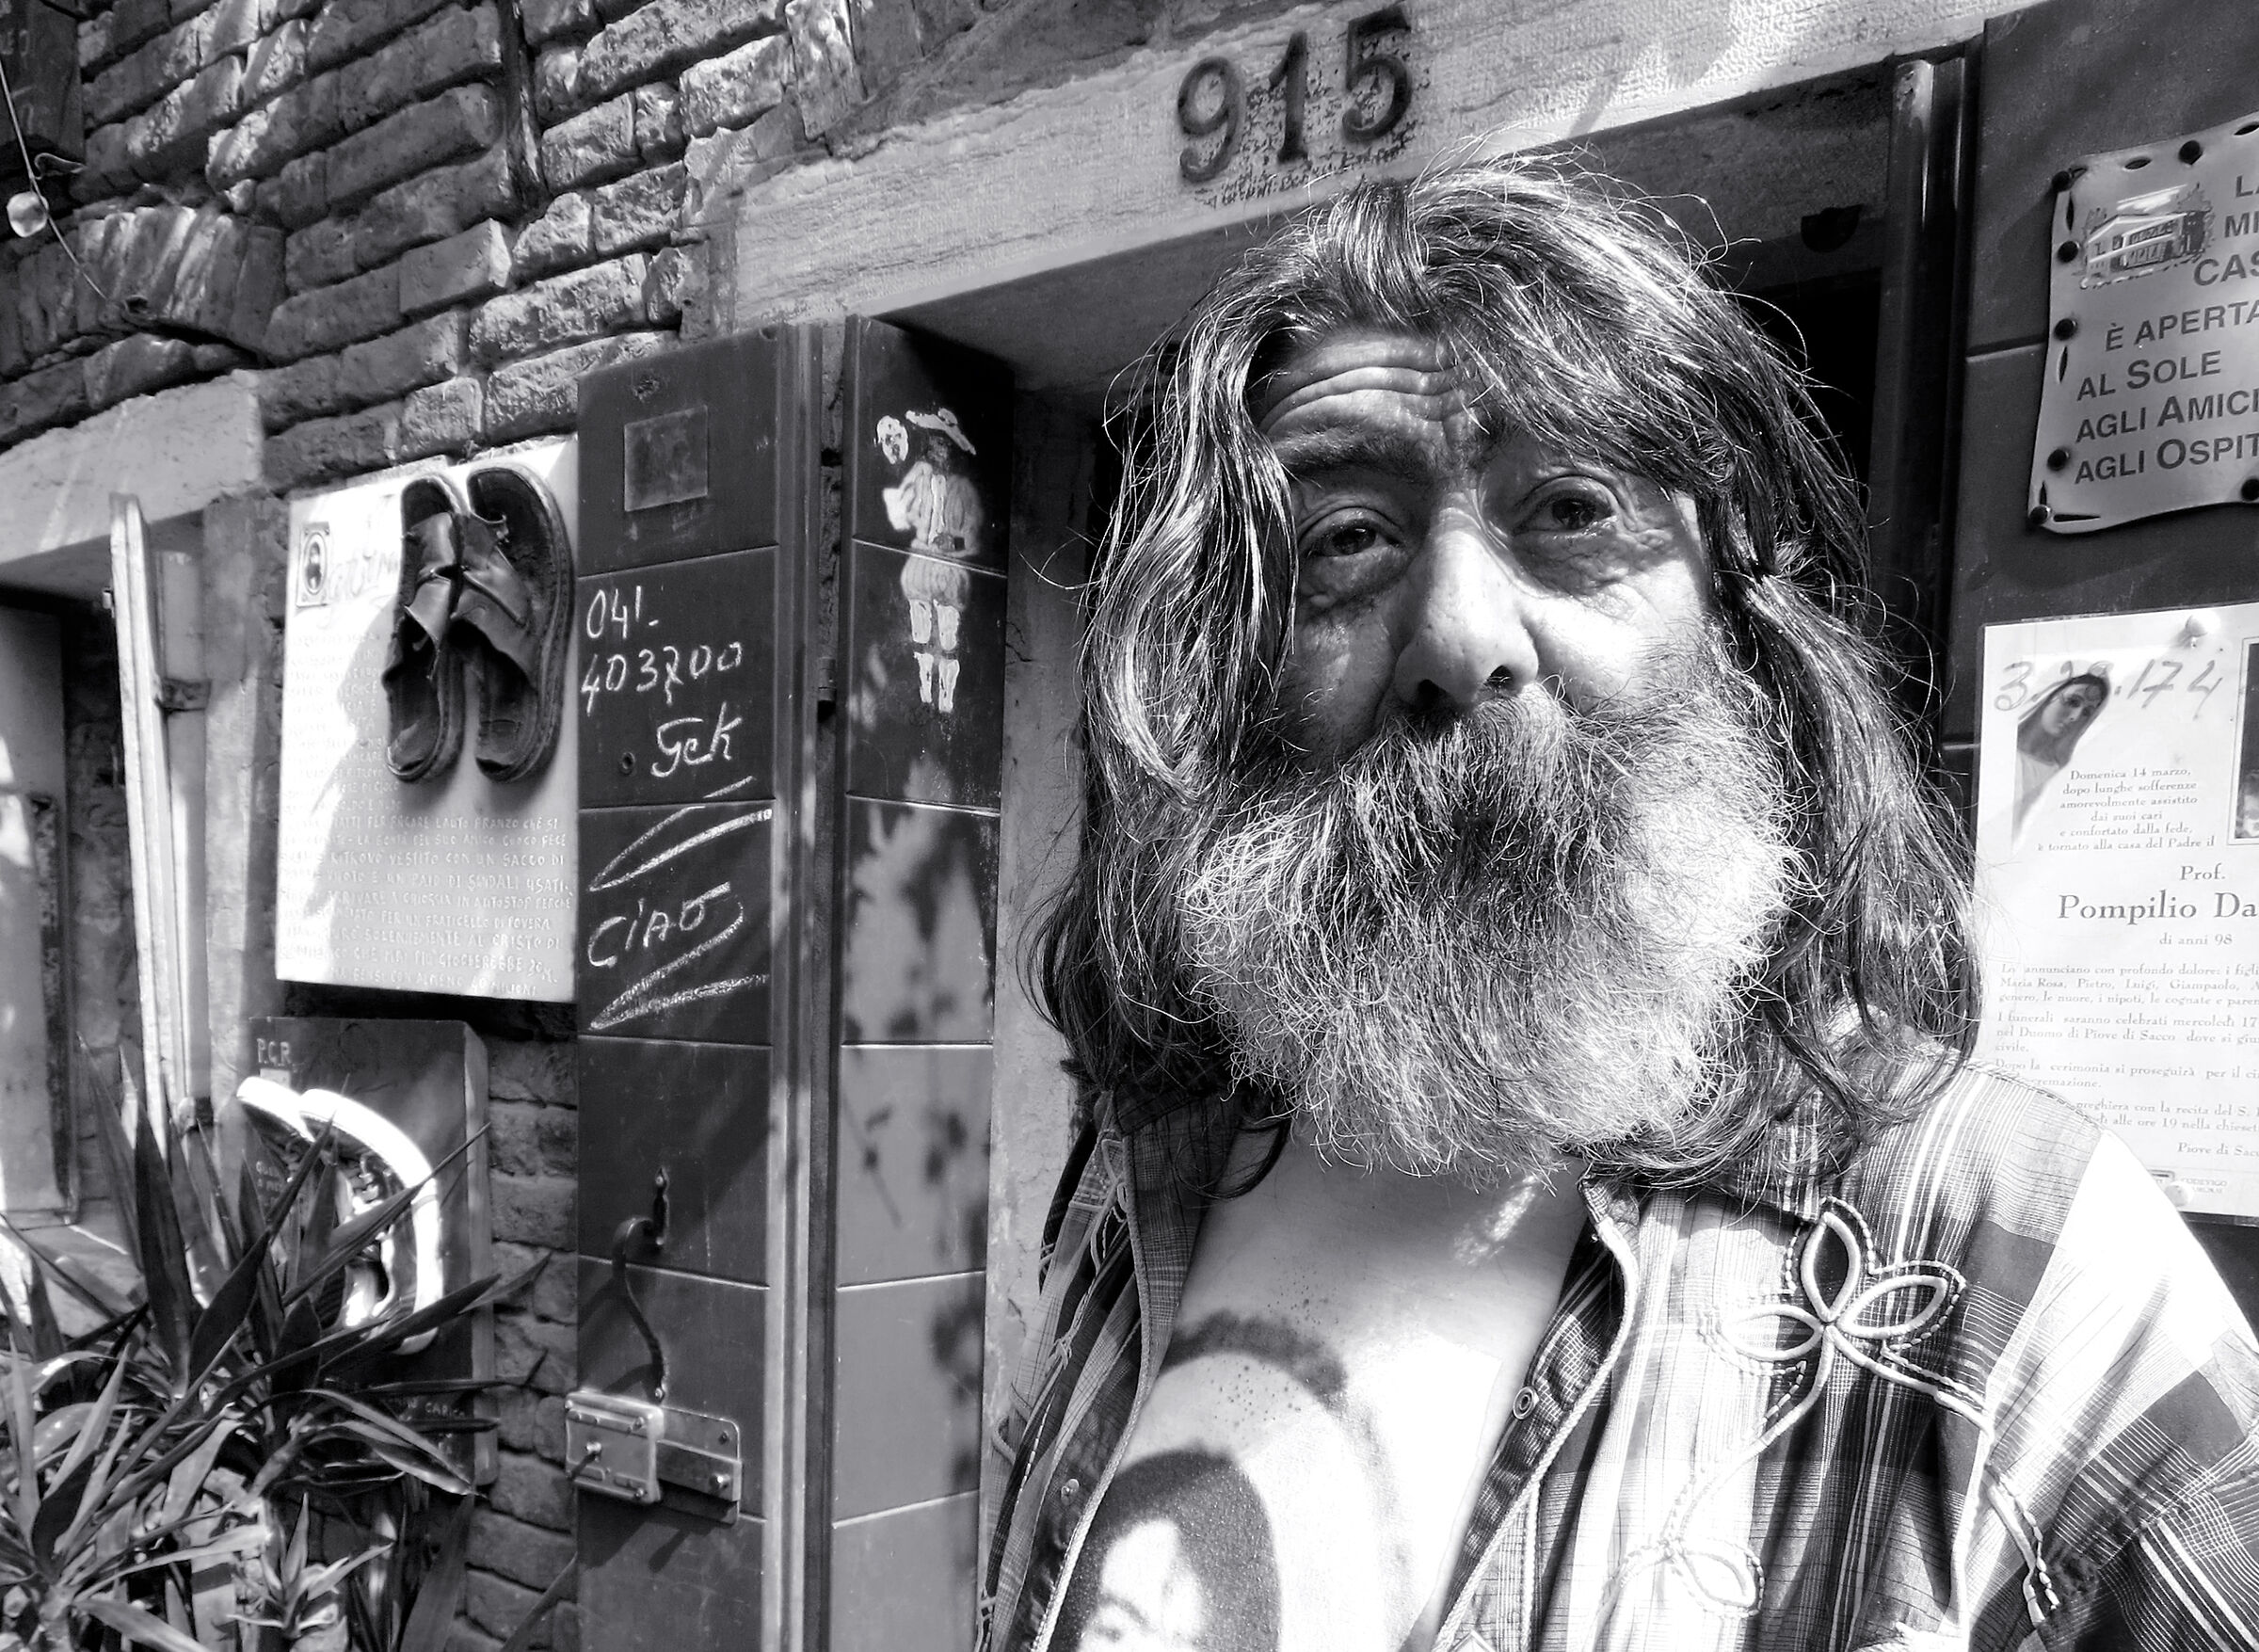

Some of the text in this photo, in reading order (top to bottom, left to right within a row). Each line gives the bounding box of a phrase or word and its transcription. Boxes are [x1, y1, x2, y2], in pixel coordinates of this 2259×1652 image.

[1178, 4, 1412, 184] 915
[2235, 175, 2259, 198] L
[2076, 350, 2221, 402] AL SOLE
[2075, 388, 2259, 443] AGLI AMICI
[2075, 450, 2145, 485] AGLI
[2070, 767, 2192, 780] Domenica 14 marzo,
[2062, 779, 2198, 796] dopo lunghe sofferenze
[2059, 795, 2198, 810] amorevolmente assistito
[2091, 810, 2163, 822] dai suoi cari
[2070, 825, 2128, 837] confortato
[2133, 823, 2160, 835] dalla
[2166, 822, 2193, 834] fede,
[2048, 842, 2090, 851] tornato
[2093, 838, 2113, 850] alla
[2118, 842, 2141, 850] casa
[2145, 837, 2163, 848] del
[2168, 837, 2202, 848] Padre
[2206, 835, 2215, 847] il
[502, 852, 546, 867] SACCO
[551, 853, 565, 866] DI
[2180, 862, 2226, 881] Prof.
[2058, 889, 2258, 925] Pompilio Da
[2159, 932, 2234, 946] di anni 98
[2025, 964, 2091, 974] annunciano
[2120, 962, 2173, 976] profondo
[1999, 977, 2033, 987] Maria
[2037, 977, 2067, 988] Rosa,
[2077, 977, 2115, 989] Pietro,
[2124, 978, 2159, 990] Luigi,
[2170, 978, 2240, 992] Giampaolo,
[1998, 993, 2039, 1003] genero,
[2043, 990, 2053, 1002] le
[2057, 995, 2093, 1003] nuore,
[2107, 993, 2145, 1005] nipoti,
[2149, 991, 2160, 1003] le
[2164, 996, 2211, 1005] cognate
[2008, 1009, 2054, 1023] funerali
[2115, 1012, 2168, 1025] celebrati
[2242, 1016, 2258, 1028] 17
[1996, 1024, 2014, 1036] nel
[2019, 1026, 2063, 1037] Duomo
[2067, 1026, 2079, 1038] di
[2084, 1027, 2118, 1040] Piove
[2123, 1027, 2135, 1040] di
[2139, 1029, 2176, 1041] Sacco
[2186, 1030, 2216, 1042] dove
[2220, 1033, 2232, 1043] si
[1995, 1039, 2029, 1052] civile.
[1995, 1057, 2026, 1071] Dopo
[2029, 1057, 2041, 1070] la
[2049, 1061, 2109, 1073] cerimonia
[2114, 1064, 2125, 1074] si
[2130, 1066, 2195, 1077] proseguirà
[2205, 1069, 2227, 1080] per
[2232, 1066, 2241, 1078] il
[2076, 1098, 2130, 1112] preghiera
[2134, 1104, 2156, 1113] con
[2160, 1100, 2171, 1113] la
[2175, 1103, 2209, 1115] recita
[2215, 1103, 2233, 1116] del
[2112, 1113, 2133, 1126] alle
[2138, 1118, 2156, 1128] ore
[2162, 1117, 2177, 1129] 19
[2182, 1117, 2210, 1131] nella
[2177, 1142, 2211, 1154] Piove
[2216, 1142, 2229, 1155] di
